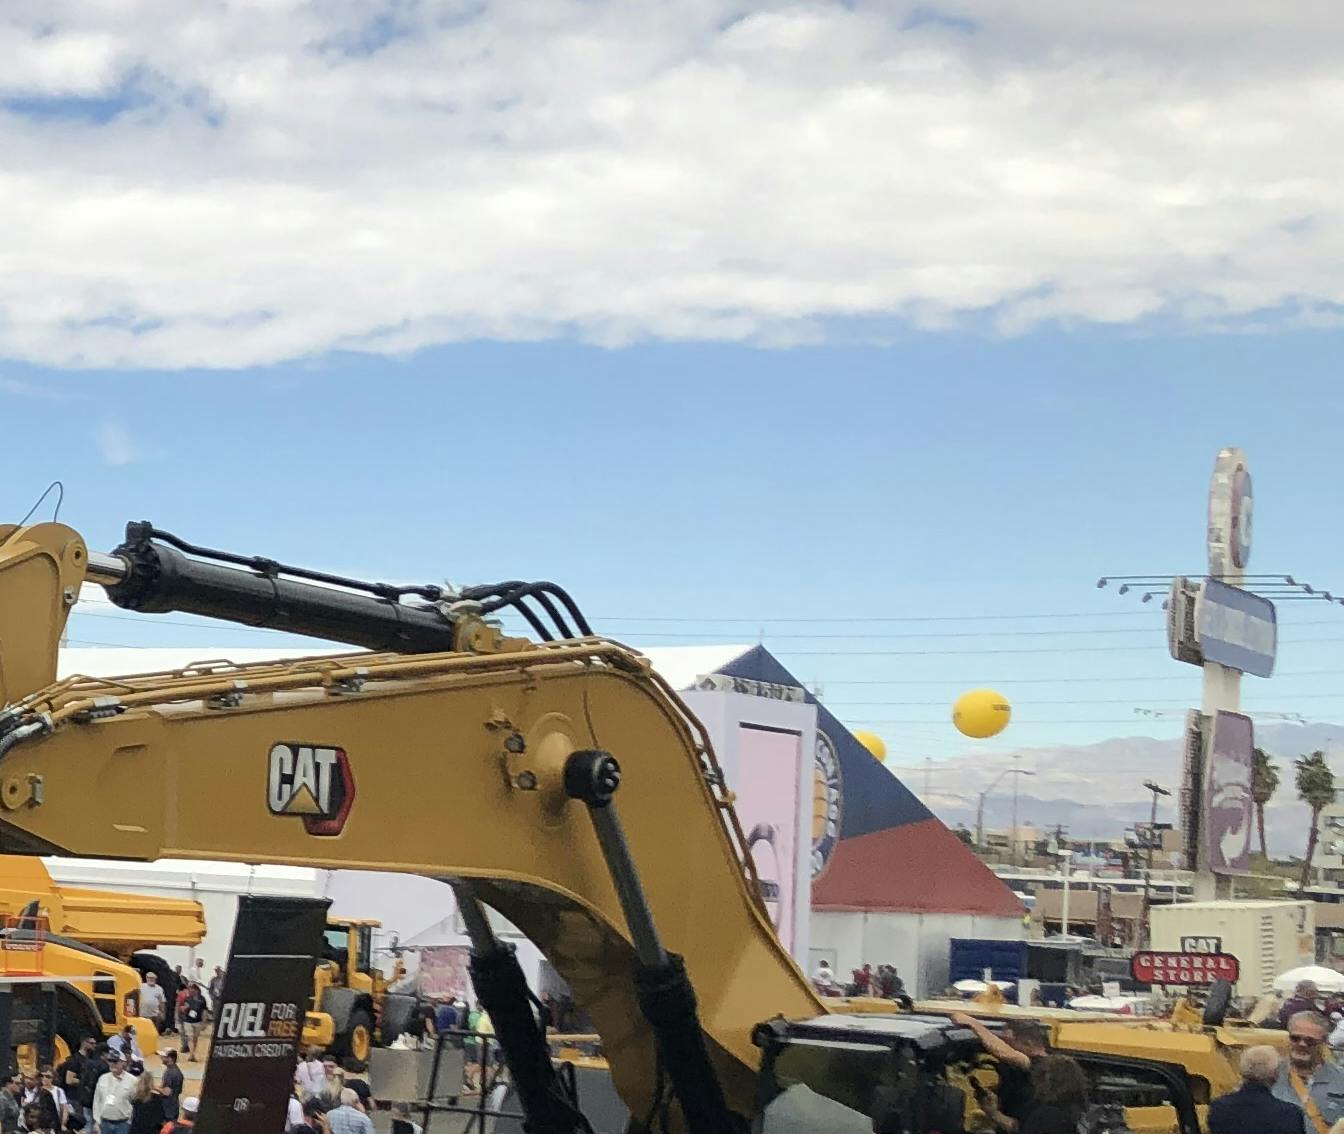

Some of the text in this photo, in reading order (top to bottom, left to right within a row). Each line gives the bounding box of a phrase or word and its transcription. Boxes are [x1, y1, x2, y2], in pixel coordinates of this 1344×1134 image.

[269, 744, 339, 815] CAT
[1185, 939, 1217, 953] CAT
[1140, 956, 1230, 969] GENERAL
[1153, 970, 1217, 982] STORE
[217, 1002, 296, 1038] FUEL FOR
[234, 1098, 250, 1112] OR
